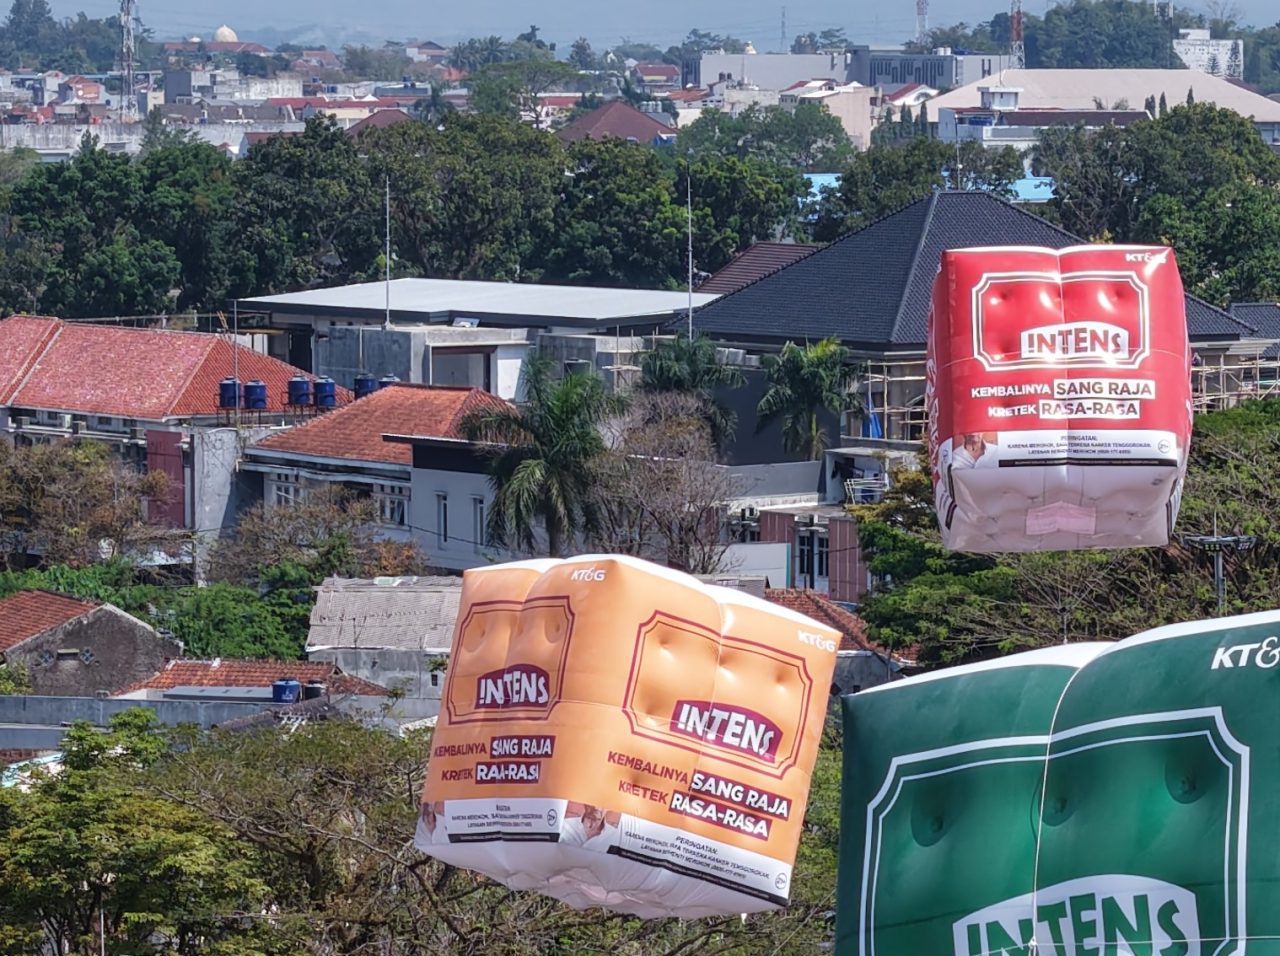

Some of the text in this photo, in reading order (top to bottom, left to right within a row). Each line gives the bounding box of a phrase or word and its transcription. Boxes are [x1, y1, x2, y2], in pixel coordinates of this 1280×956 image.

[971, 381, 1152, 398] KEMBALINYA SANG RAJA
[988, 401, 1138, 417] KRETEK RASA-RASA
[570, 568, 605, 582] KT&G
[797, 629, 837, 654] KT&G
[521, 738, 552, 755] RAJA
[607, 751, 788, 817] KEMBALINYA SANG RAJA
[618, 780, 768, 837] KRETEK RASA-RASA
